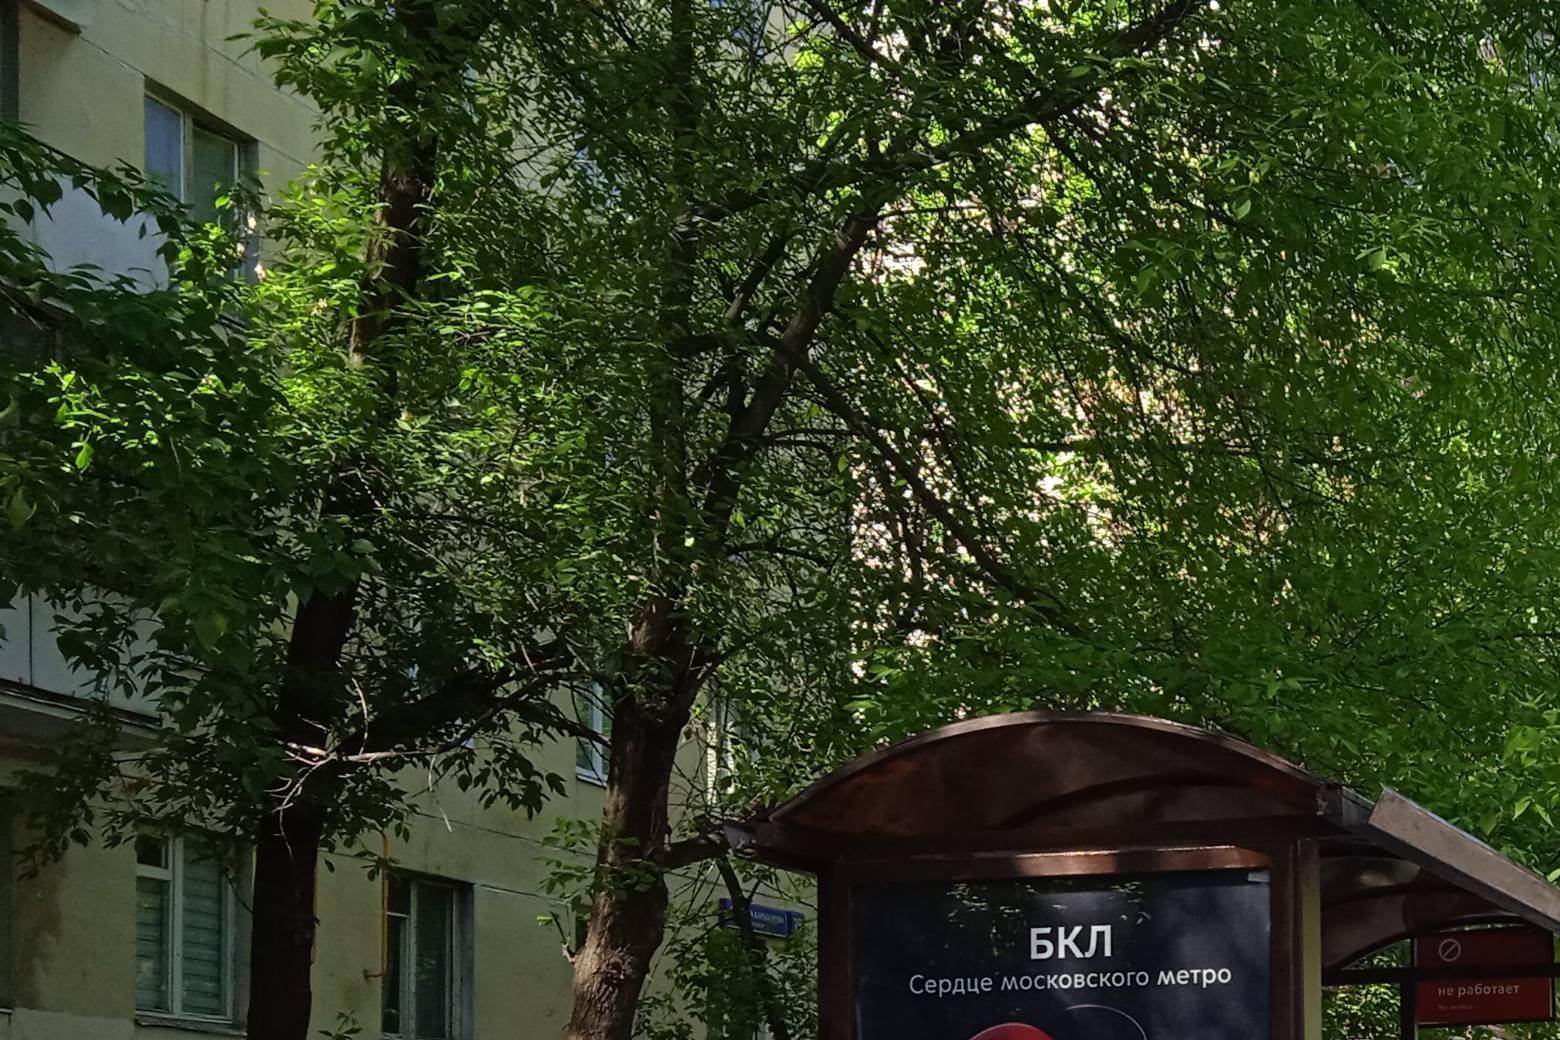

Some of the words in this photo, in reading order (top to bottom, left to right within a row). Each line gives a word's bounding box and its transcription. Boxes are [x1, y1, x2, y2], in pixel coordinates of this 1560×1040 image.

[1030, 924, 1112, 960] БКЛ
[909, 974, 993, 998] Сердце
[1001, 970, 1149, 992] московского
[1157, 966, 1232, 989] метро
[1438, 987, 1454, 996] не
[1458, 984, 1520, 998] работает
